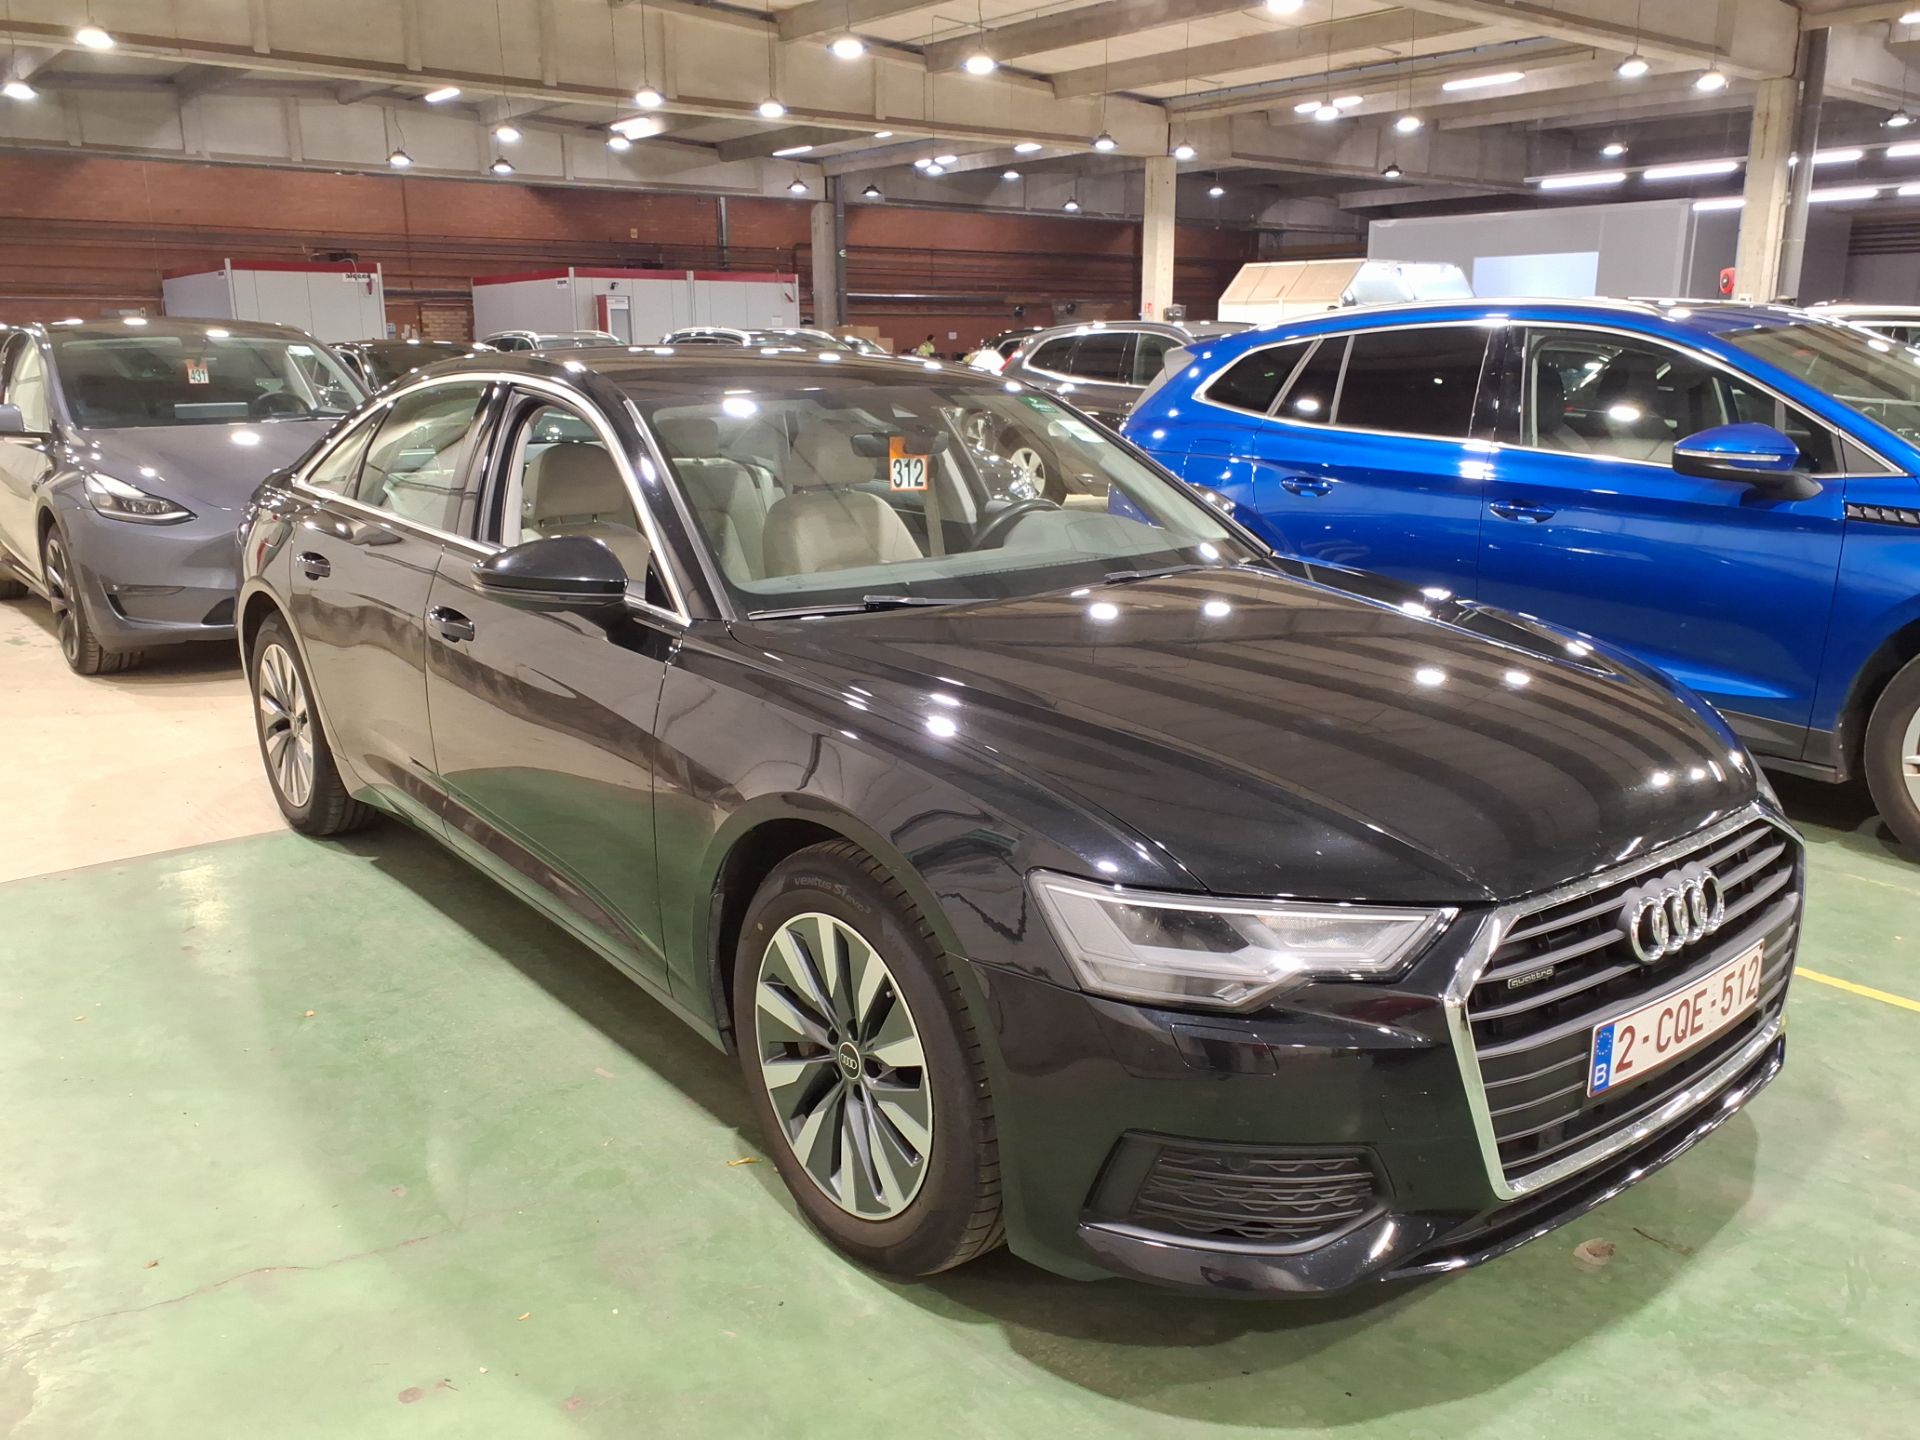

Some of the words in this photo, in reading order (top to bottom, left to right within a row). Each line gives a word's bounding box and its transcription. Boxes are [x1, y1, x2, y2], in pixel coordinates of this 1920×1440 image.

[893, 458, 924, 488] 312
[1511, 968, 1553, 988] quattro
[1615, 955, 1759, 1074] 2-CQE-512
[1593, 1063, 1607, 1087] B
